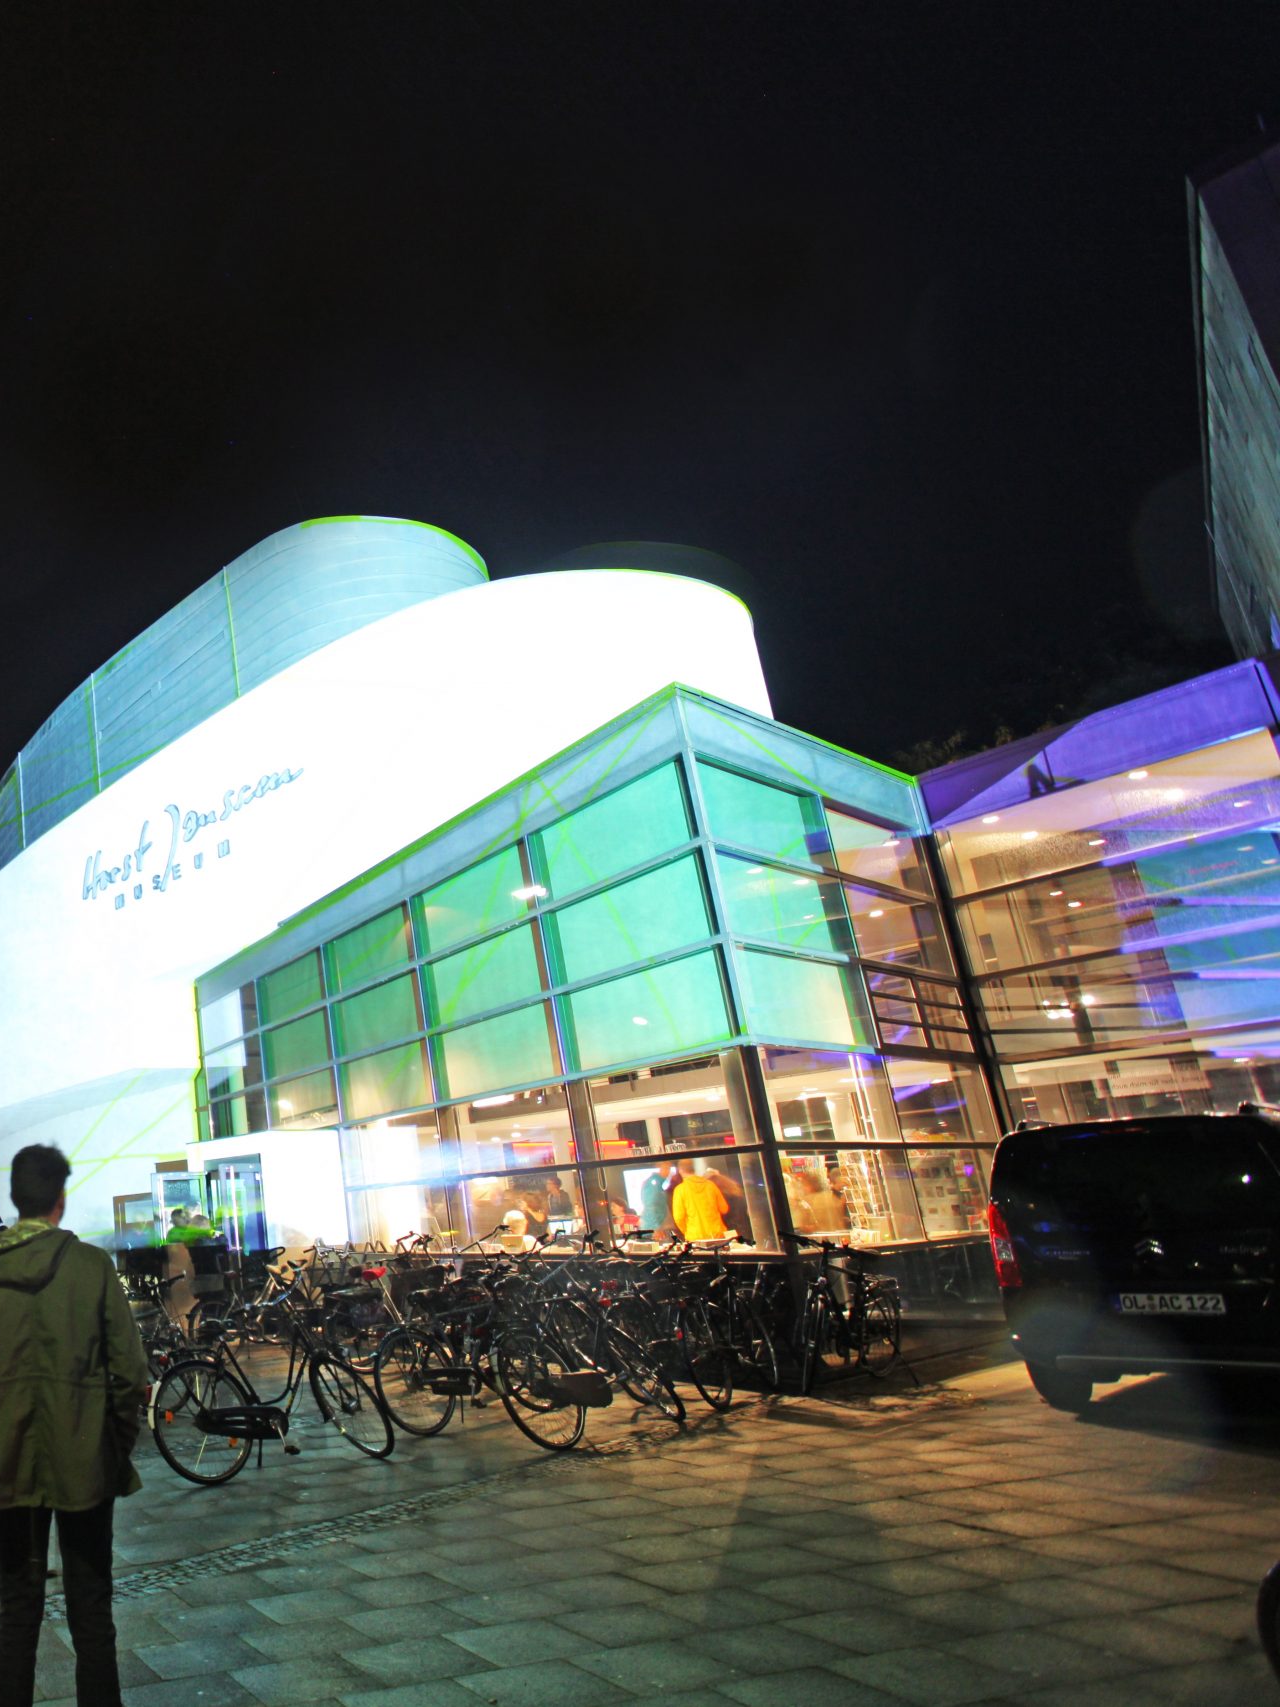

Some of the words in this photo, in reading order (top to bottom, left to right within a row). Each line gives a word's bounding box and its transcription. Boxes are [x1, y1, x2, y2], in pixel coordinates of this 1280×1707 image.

[1122, 1295, 1146, 1310] OL
[1159, 1295, 1182, 1311] AC
[1186, 1295, 1223, 1312] 122
